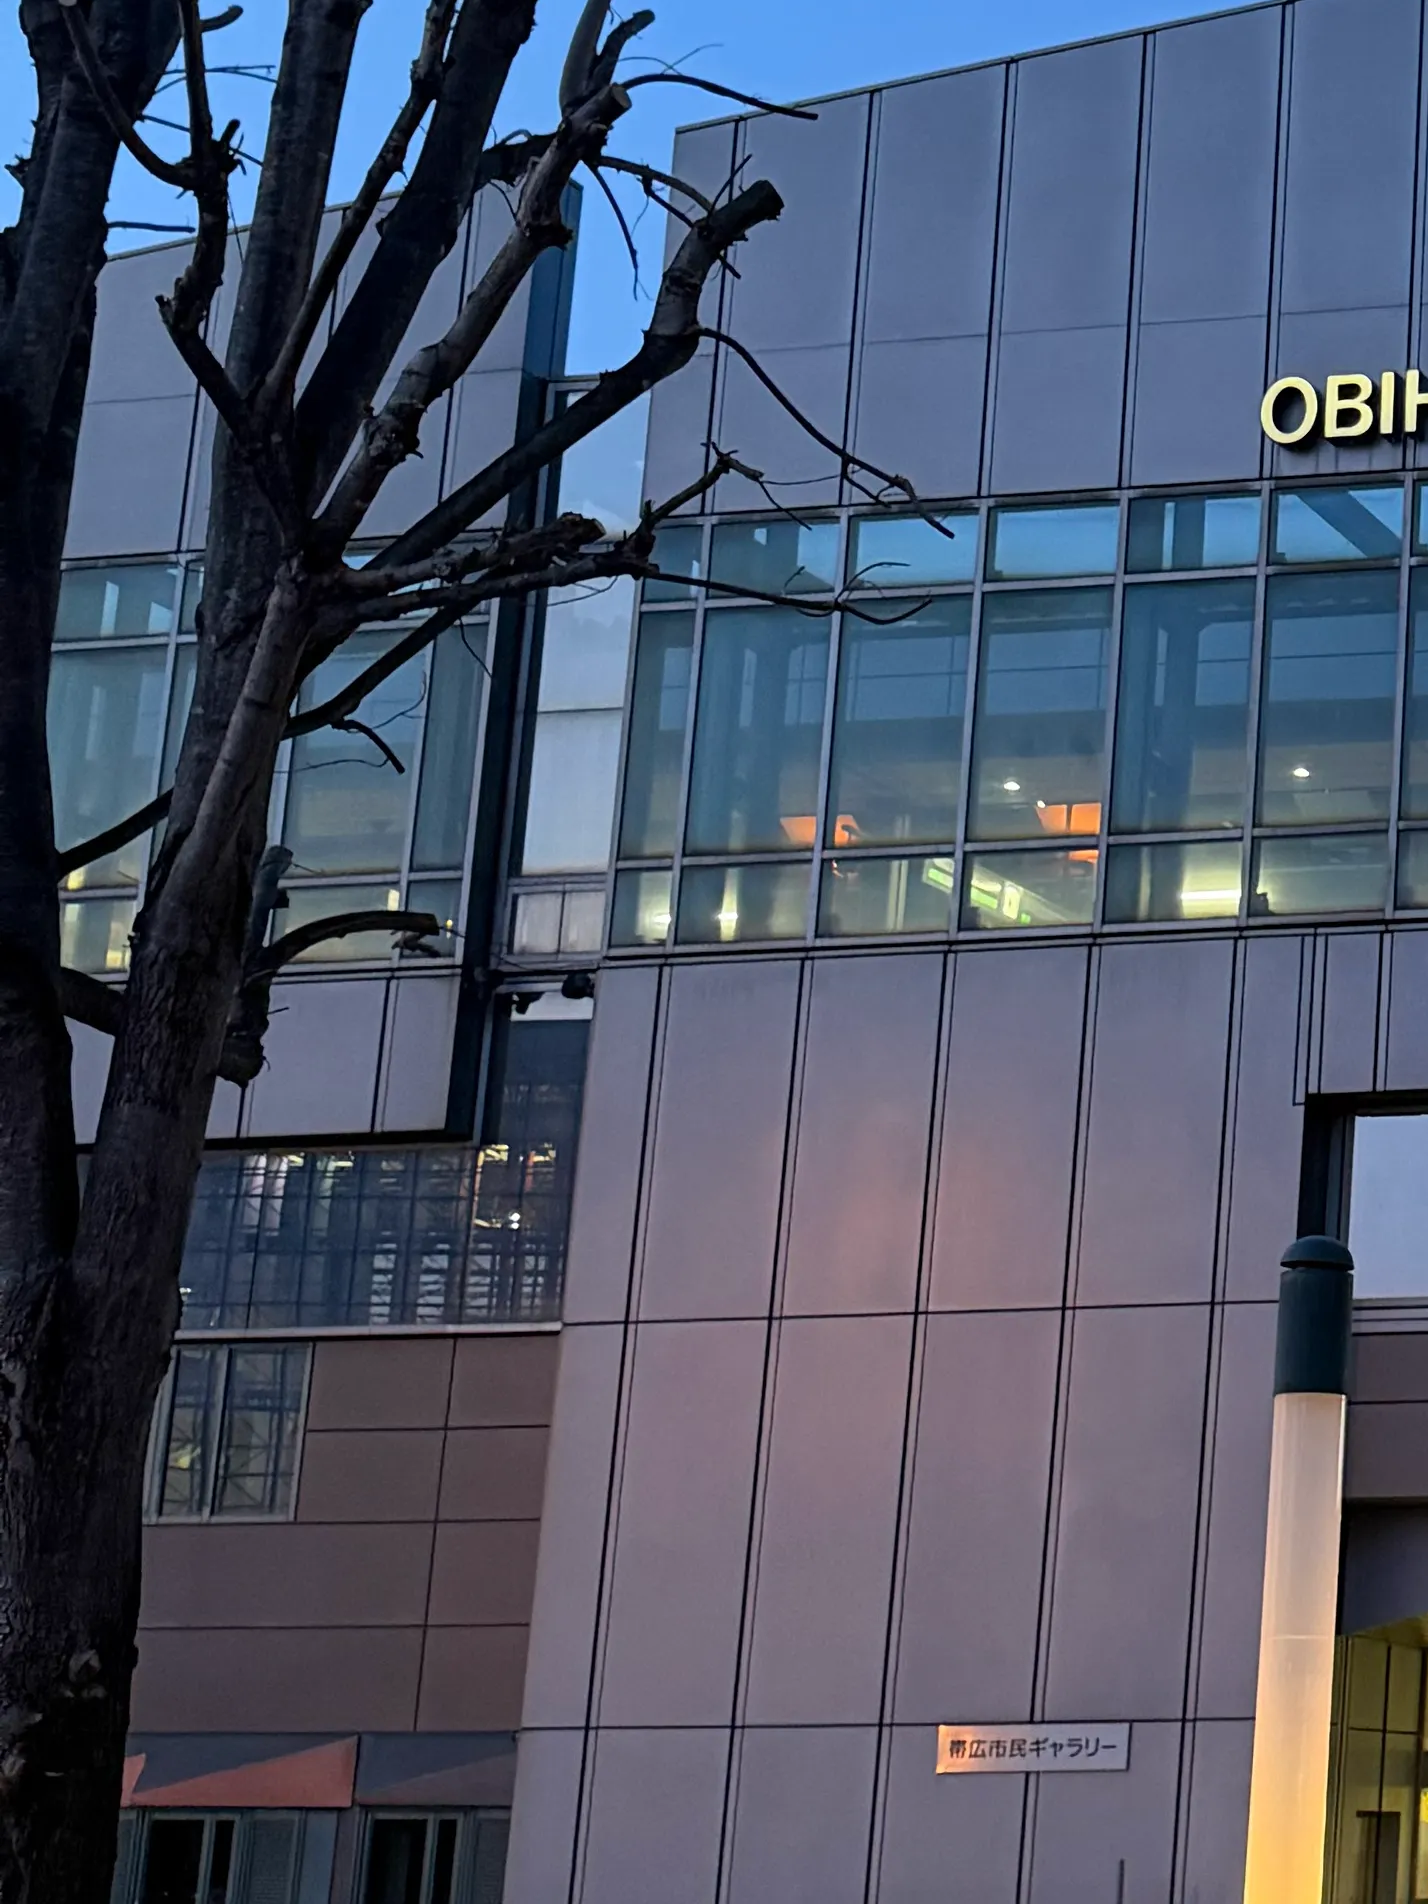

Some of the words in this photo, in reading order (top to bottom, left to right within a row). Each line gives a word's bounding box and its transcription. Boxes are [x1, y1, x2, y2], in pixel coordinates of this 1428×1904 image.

[949, 1735, 1118, 1760] 帯広市民ギャラリー
